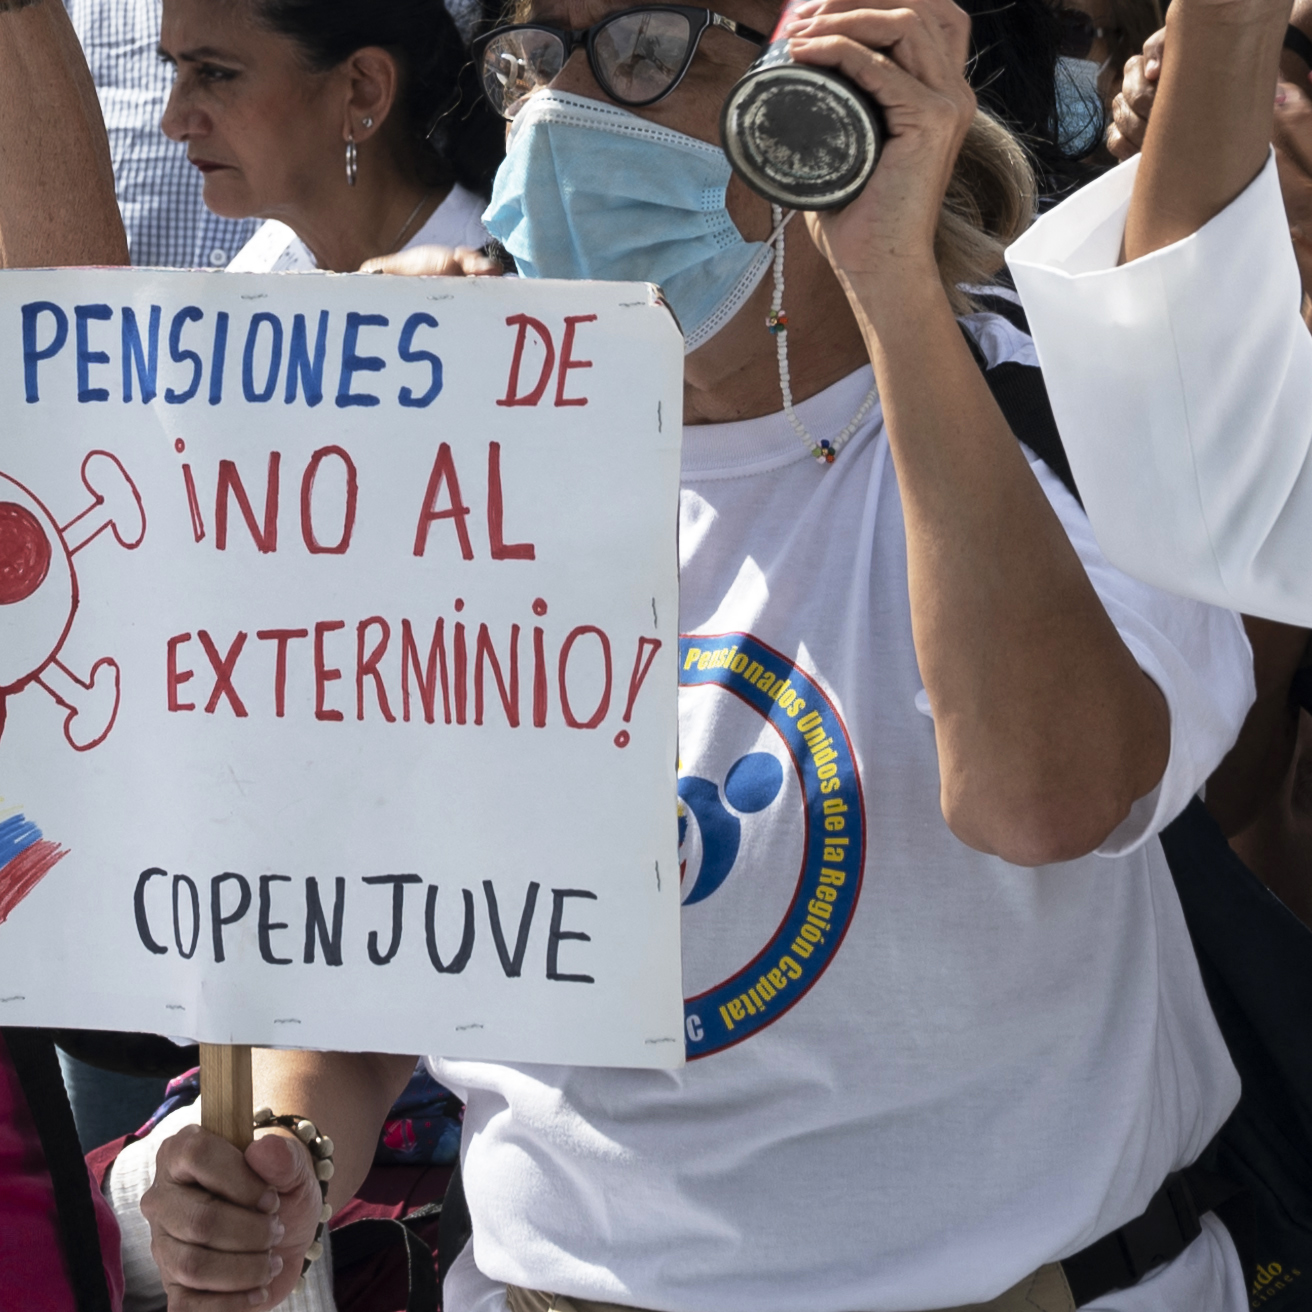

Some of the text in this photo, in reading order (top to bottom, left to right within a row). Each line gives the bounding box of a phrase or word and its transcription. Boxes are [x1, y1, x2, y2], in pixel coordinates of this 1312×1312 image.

[21, 302, 443, 409] PENSIONES
[497, 313, 598, 407] DE
[413, 442, 535, 560] AL
[683, 645, 849, 1030] Pensionados Unidos de la Región Capital
[132, 867, 596, 983] COPENJUVE
